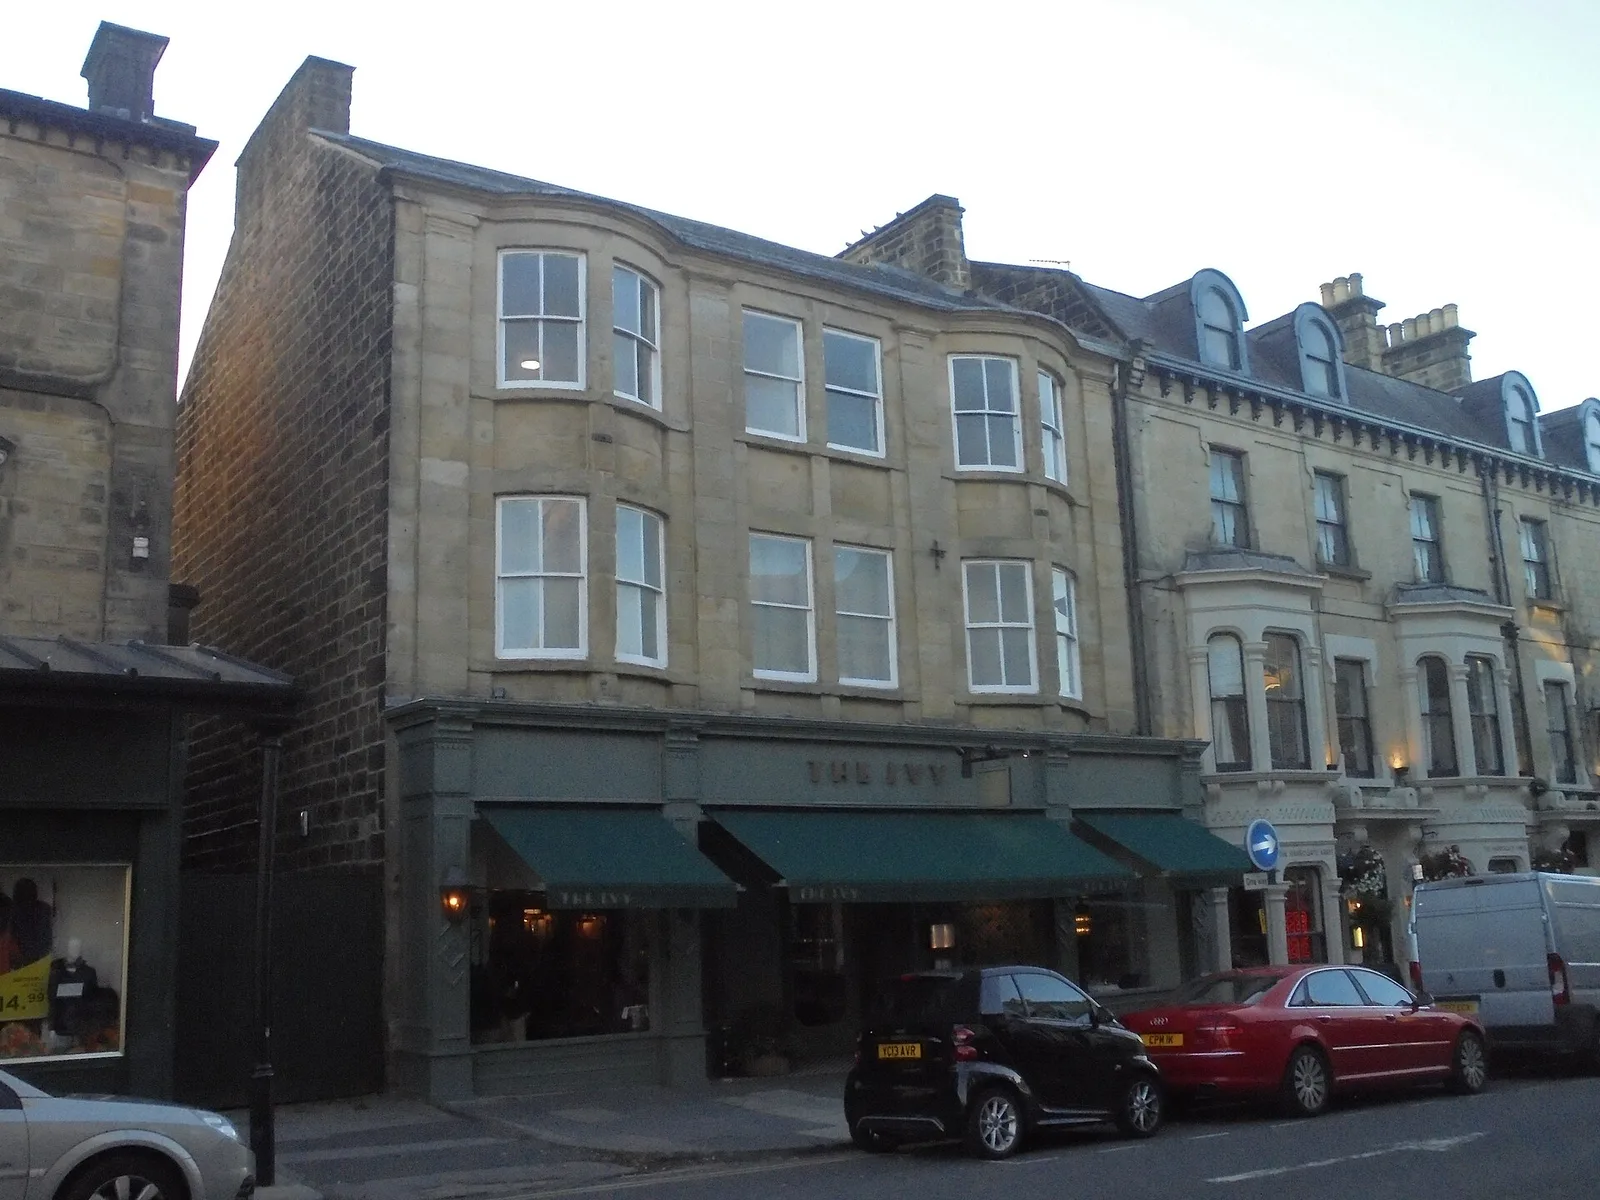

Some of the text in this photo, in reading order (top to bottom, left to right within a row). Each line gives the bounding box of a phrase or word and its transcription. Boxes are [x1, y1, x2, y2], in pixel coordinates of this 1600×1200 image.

[807, 760, 947, 786] THE IVY
[559, 891, 631, 905] THE IVY
[882, 1044, 916, 1058] YC13 AVR
